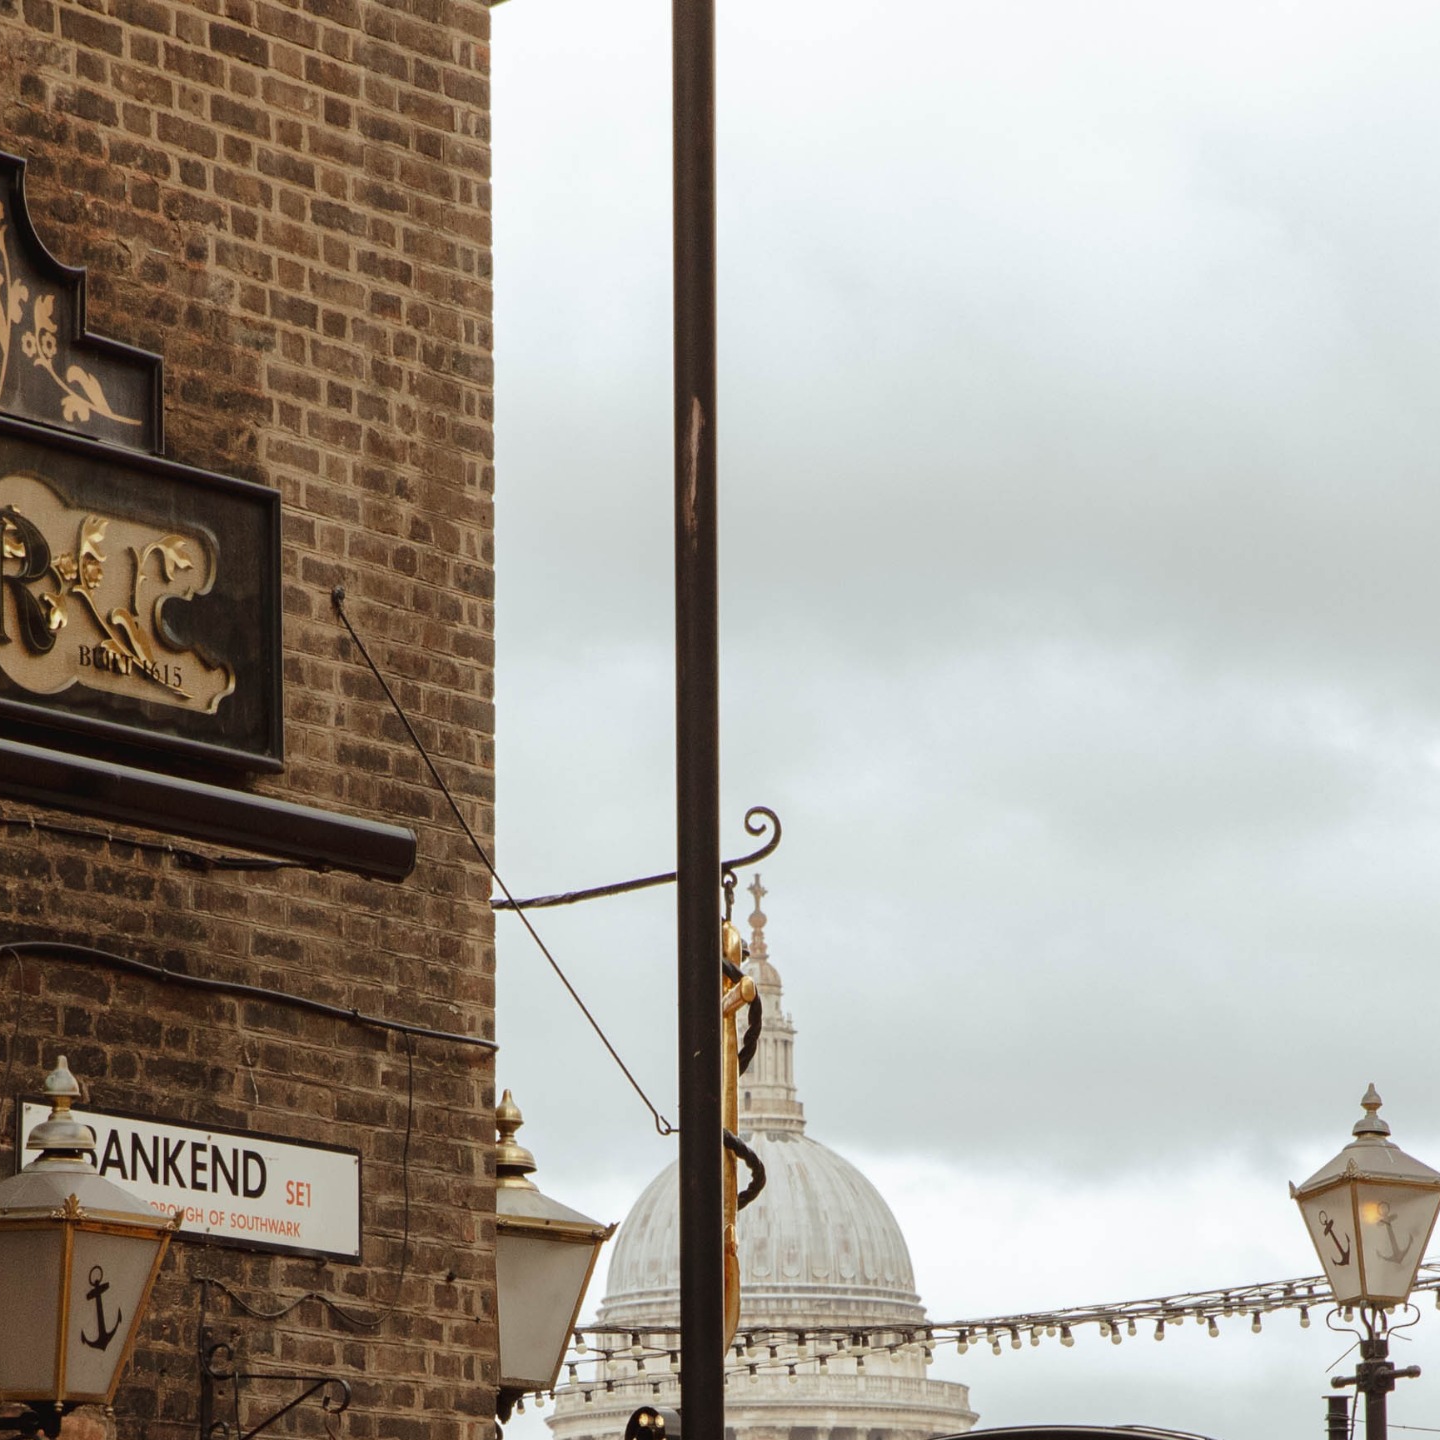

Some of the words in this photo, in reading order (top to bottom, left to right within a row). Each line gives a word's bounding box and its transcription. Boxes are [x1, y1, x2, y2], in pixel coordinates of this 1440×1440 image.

[78, 644, 133, 676] BUILT
[142, 659, 182, 688] 1615
[286, 1180, 311, 1208] SE1
[209, 1209, 225, 1227] OF
[230, 1213, 301, 1238] SOUTHWARK
